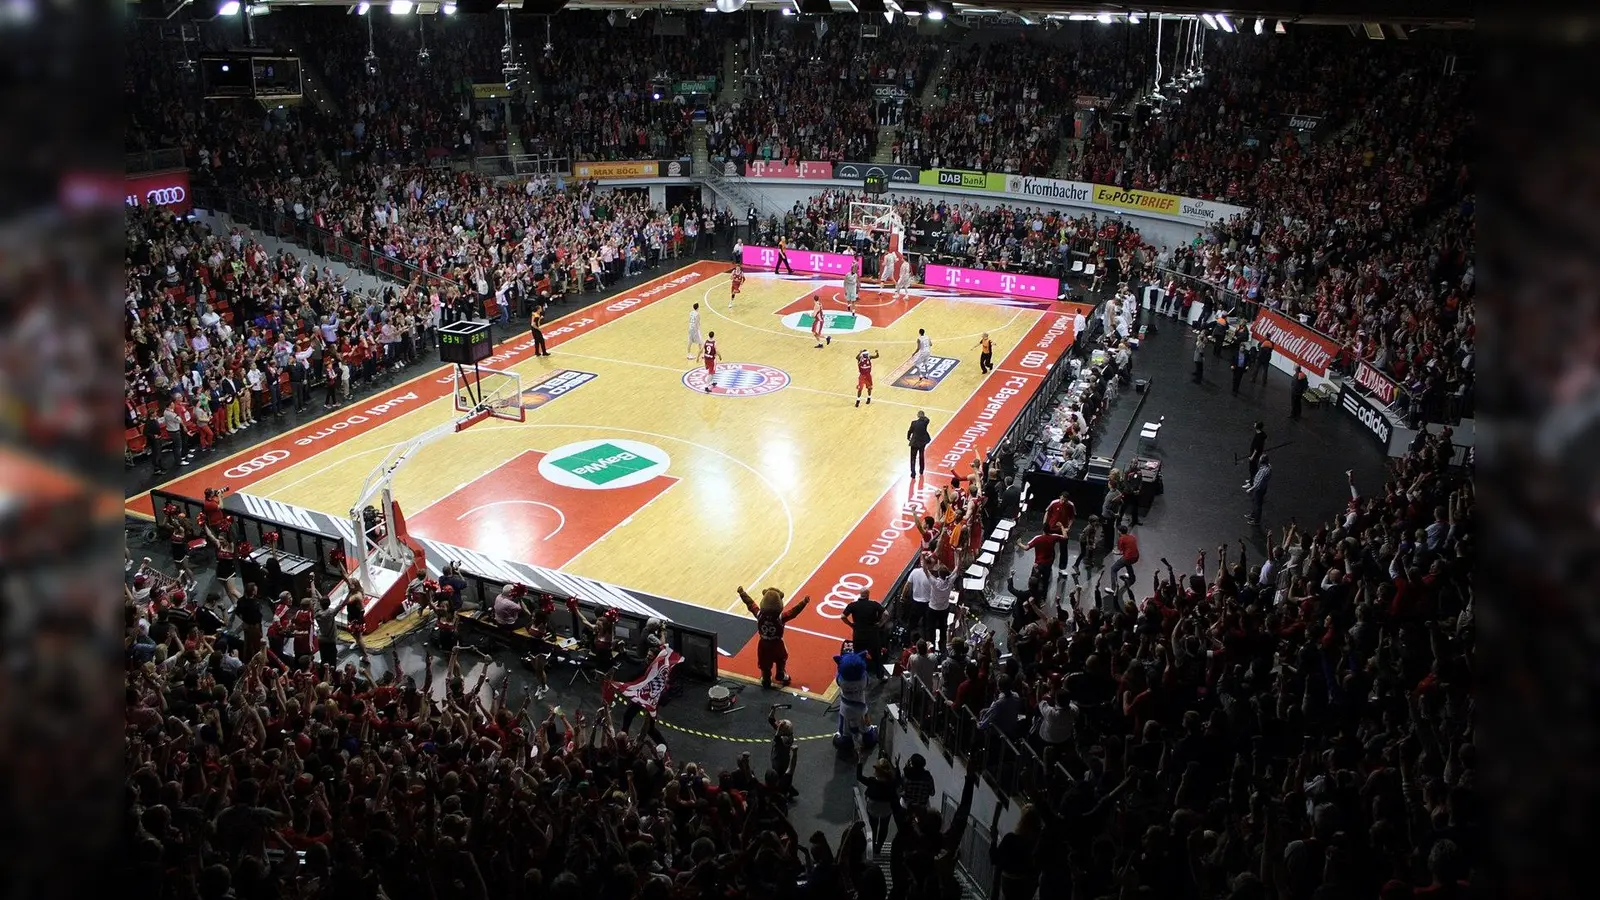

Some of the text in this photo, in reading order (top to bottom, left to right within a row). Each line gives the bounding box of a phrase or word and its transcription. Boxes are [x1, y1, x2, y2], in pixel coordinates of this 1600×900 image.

[1290, 117, 1316, 128] bwin
[616, 167, 639, 175] BÖGL
[940, 173, 984, 186] DAB bank
[1024, 178, 1088, 201] Krombacher
[1183, 205, 1214, 219] SPALDING
[568, 317, 595, 328] FC
[294, 391, 419, 446] Audi Dome
[937, 376, 1029, 468] FC Bayern München
[1357, 406, 1389, 444] adidas
[571, 451, 638, 475] BayWa
[859, 518, 916, 567] Dome
